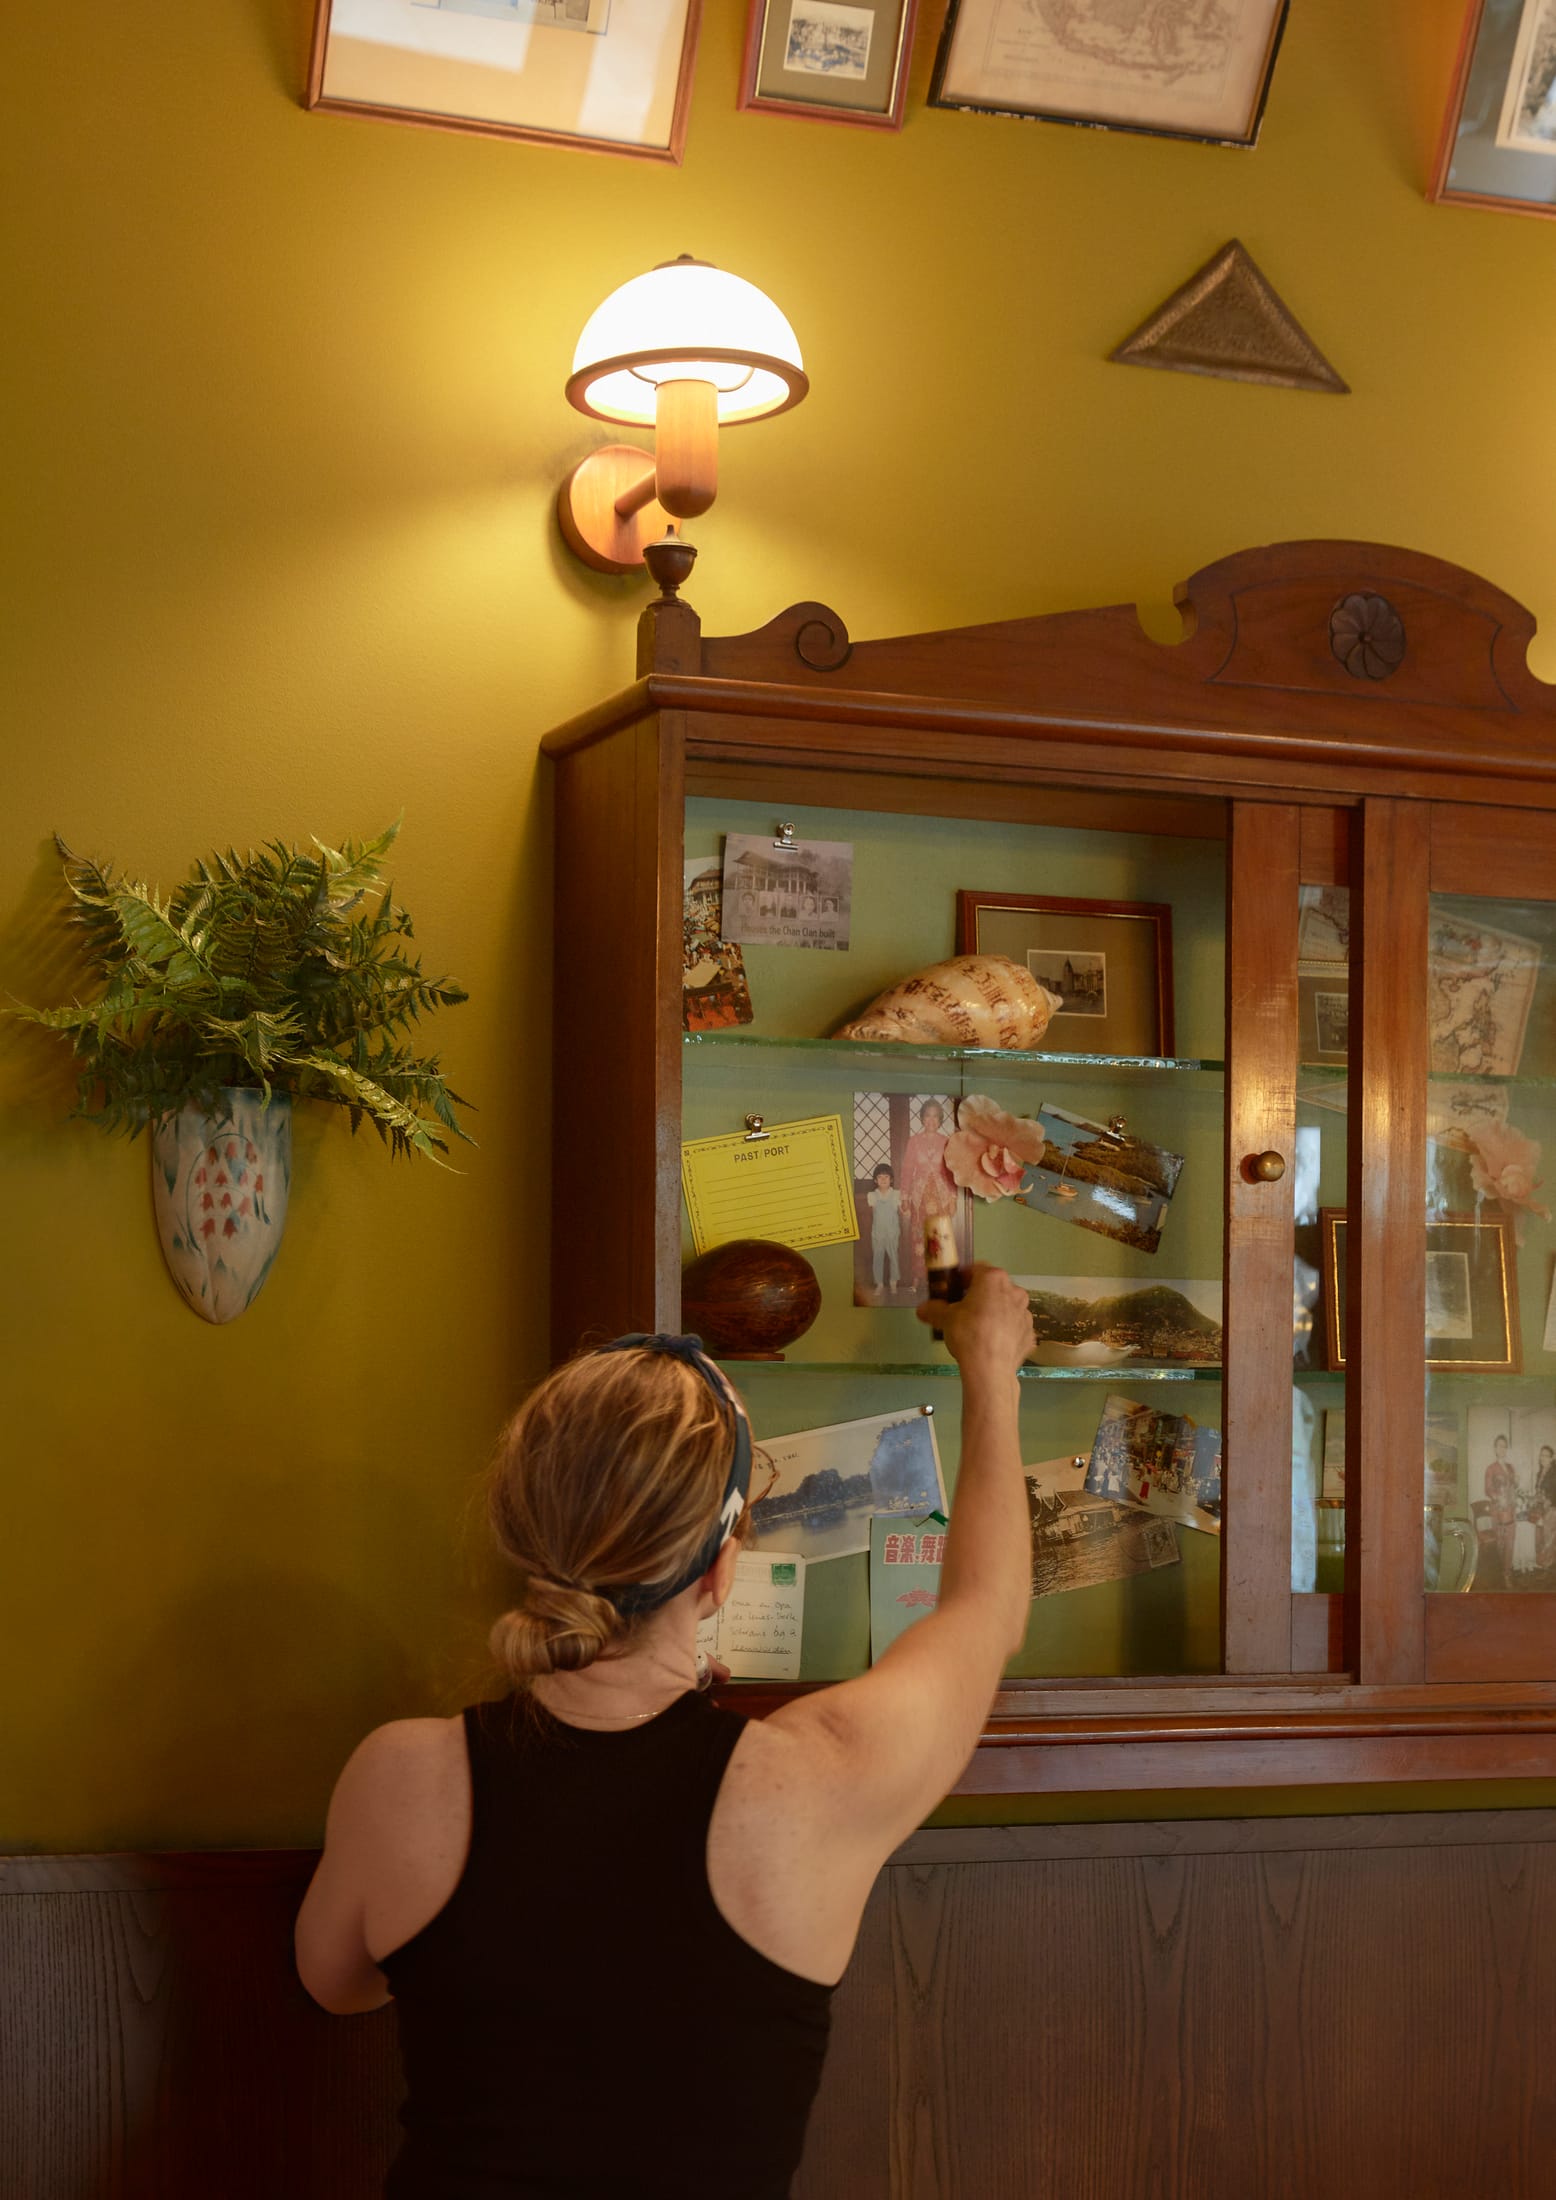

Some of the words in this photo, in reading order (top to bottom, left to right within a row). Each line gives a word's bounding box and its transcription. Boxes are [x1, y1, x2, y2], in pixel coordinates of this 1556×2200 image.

[769, 926, 781, 935] the
[783, 926, 800, 936] Chan
[802, 927, 817, 938] Clan
[820, 928, 835, 939] built
[734, 1151, 759, 1163] PAST
[764, 1145, 790, 1158] PORT
